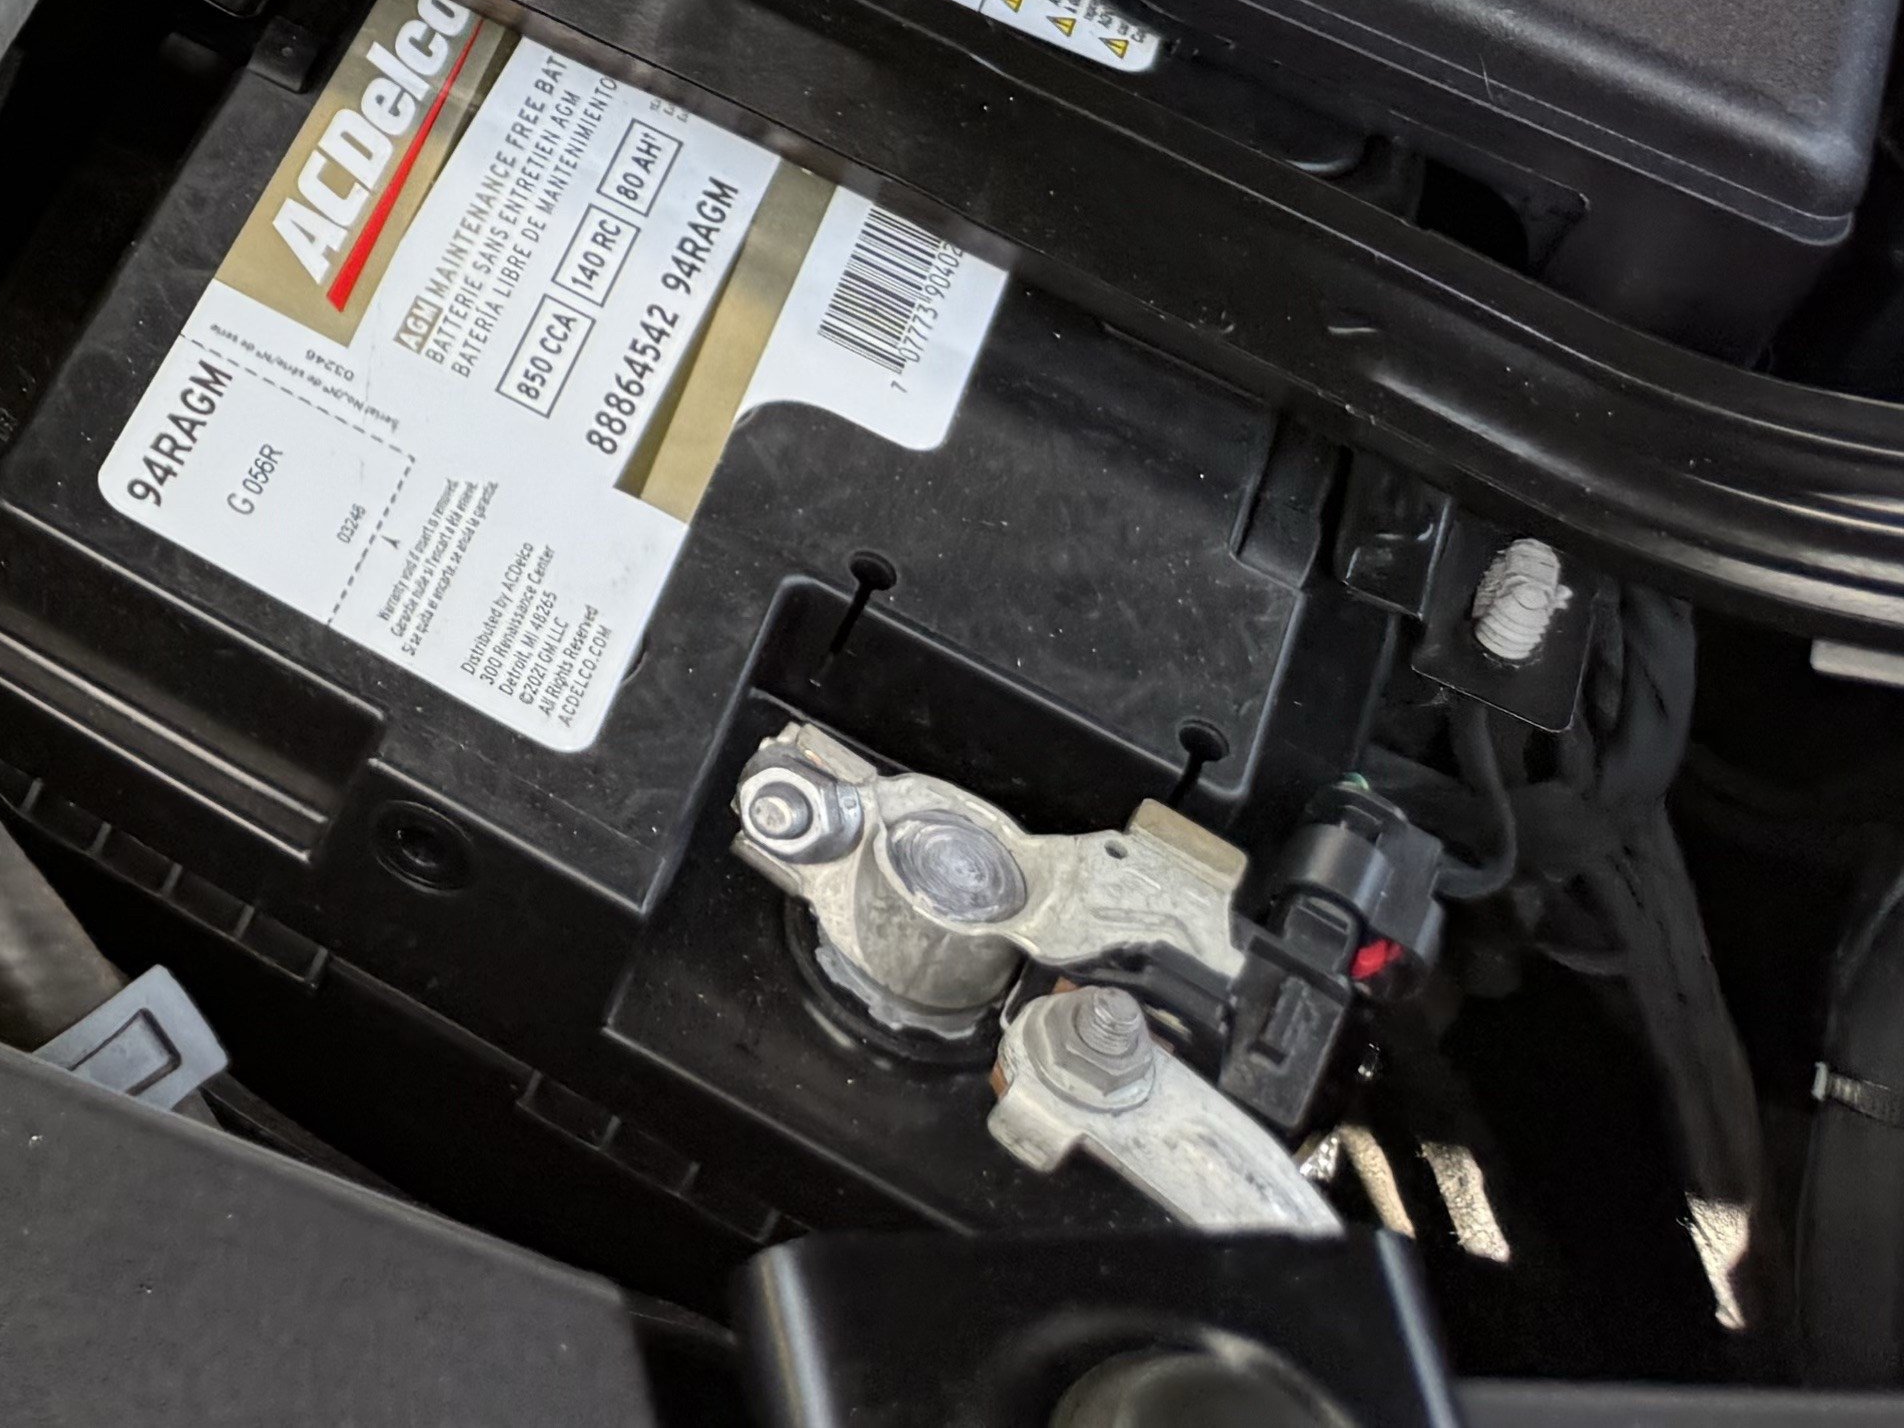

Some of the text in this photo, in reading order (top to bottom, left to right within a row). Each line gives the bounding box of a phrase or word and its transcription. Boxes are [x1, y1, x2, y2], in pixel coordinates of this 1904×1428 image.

[395, 49, 571, 350] AGM MAINTENANCE FREE BAT
[422, 87, 582, 365] BATTERIE SANS ENTRETIEN AGM
[444, 74, 620, 378] BATERÍA LIBRE DE MANTENIMIENTO
[614, 170, 647, 203] 80
[569, 216, 623, 292] 140 RC
[302, 347, 356, 383] 03246
[514, 307, 578, 402] 850 CCA
[581, 299, 682, 457] 88864542
[656, 175, 741, 299] 94RAGM
[896, 300, 941, 365] 07773
[123, 358, 234, 510] 94RAGM
[889, 379, 907, 395] 7
[222, 441, 284, 519] G 056R
[459, 539, 535, 675] Distributed by ACDelco
[478, 542, 557, 686] 300 Renaissance Center
[496, 588, 559, 697] Detroit, MI 48265
[536, 603, 600, 717] All Rights Reserved
[515, 615, 570, 707] ©2021 GM LLC
[554, 623, 615, 727] ACDELCO.COM
